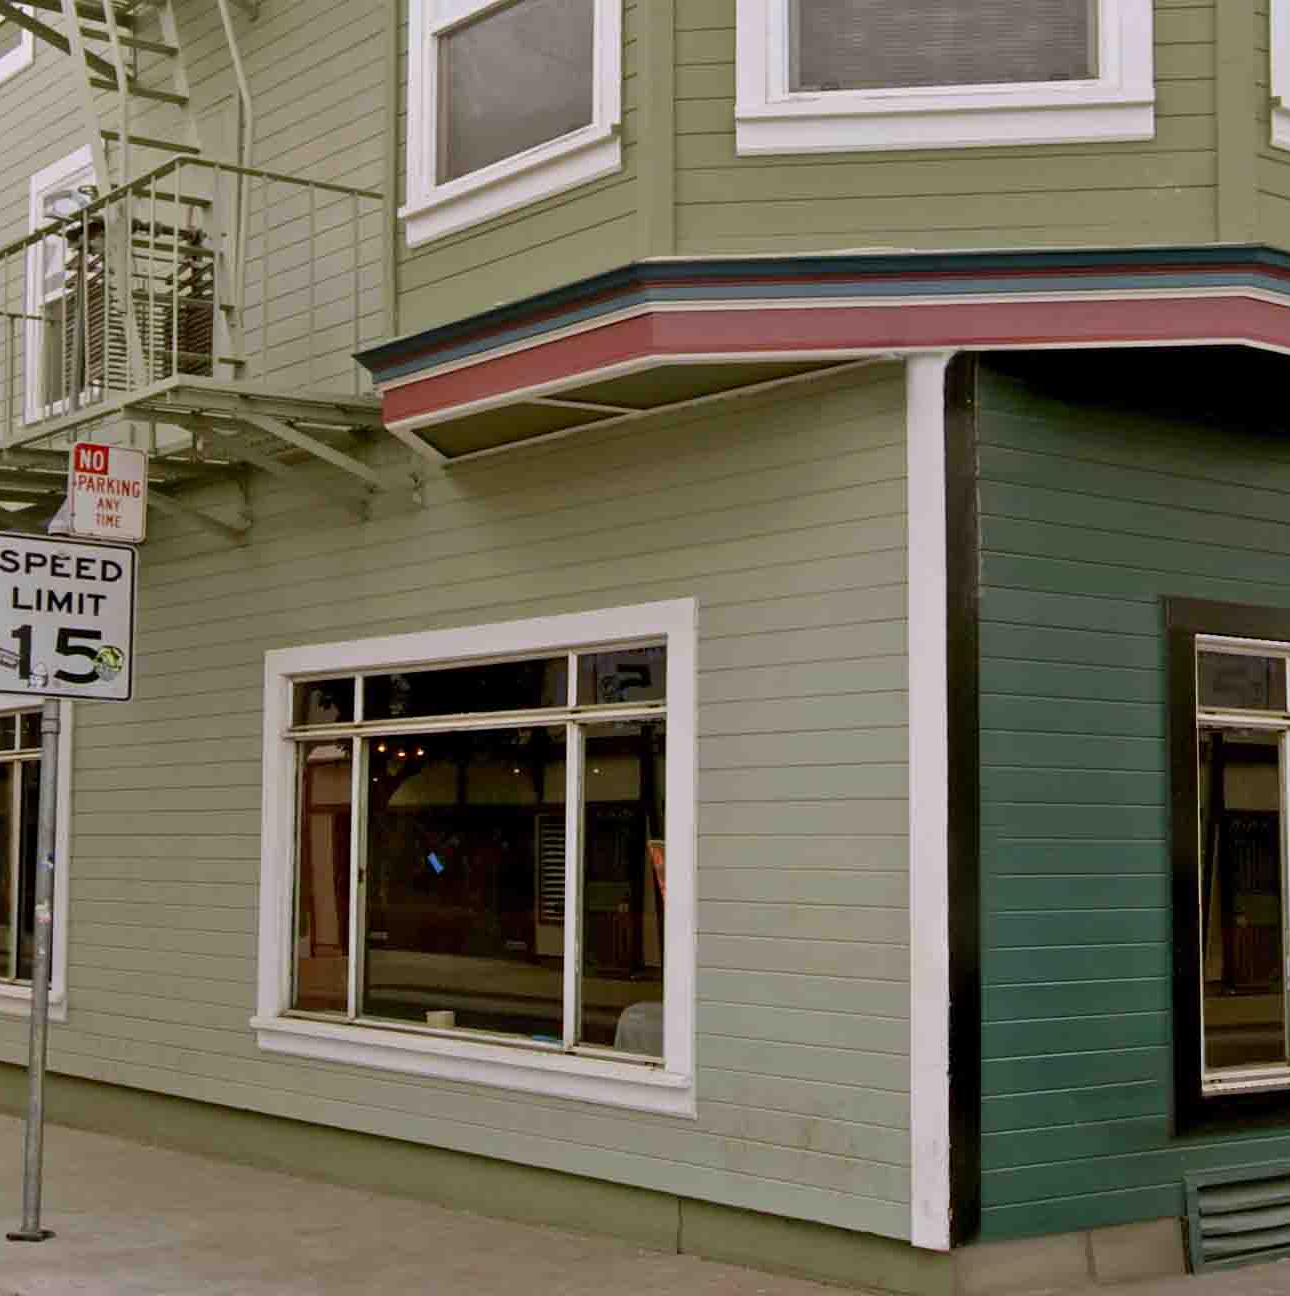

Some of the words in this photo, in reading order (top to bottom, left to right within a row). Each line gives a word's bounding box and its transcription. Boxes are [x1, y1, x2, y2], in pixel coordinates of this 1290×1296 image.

[79, 448, 105, 472] NO
[77, 474, 141, 499] PARKING
[97, 497, 122, 513] ANY
[95, 514, 122, 529] TIME
[12, 586, 107, 616] LIMIT
[10, 624, 104, 684] 15
